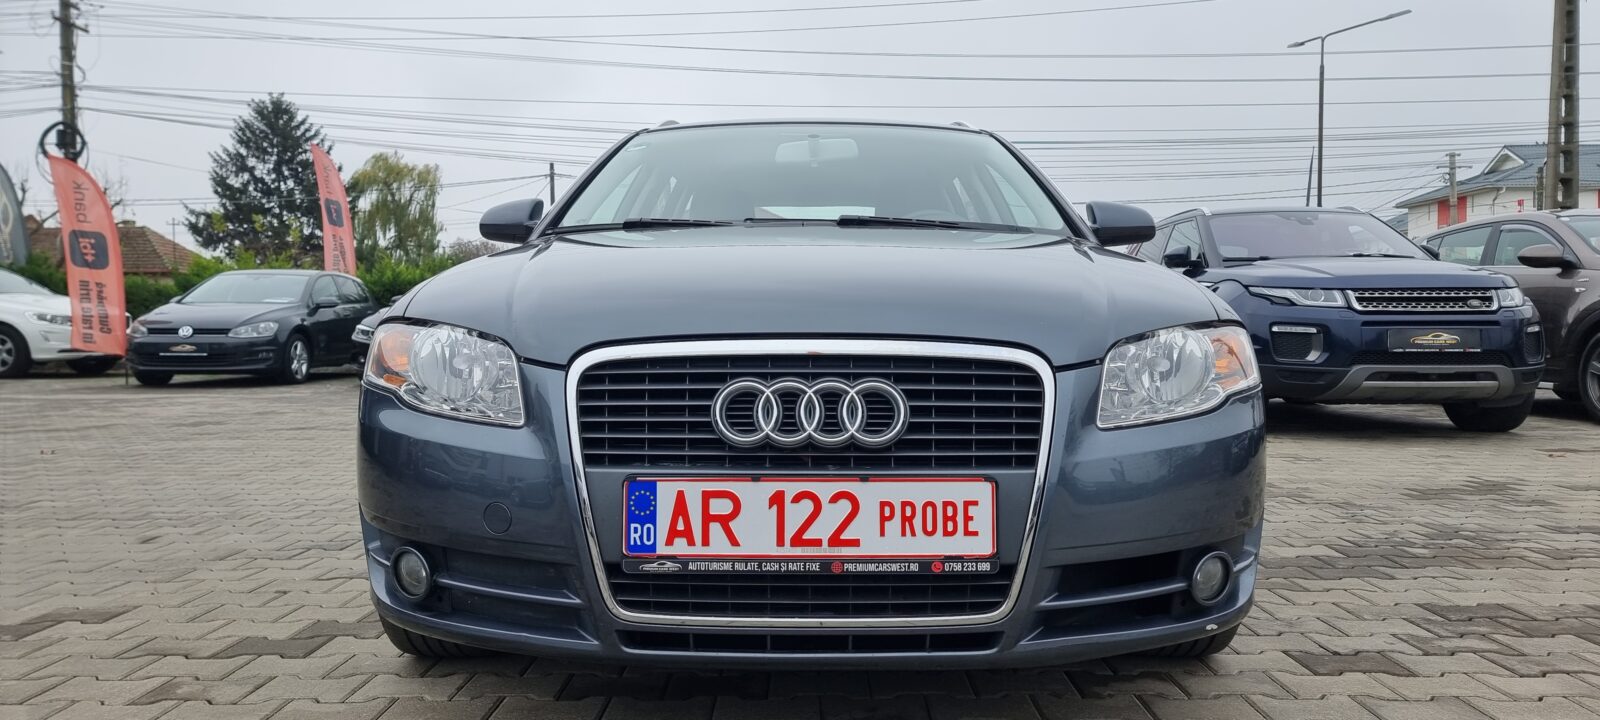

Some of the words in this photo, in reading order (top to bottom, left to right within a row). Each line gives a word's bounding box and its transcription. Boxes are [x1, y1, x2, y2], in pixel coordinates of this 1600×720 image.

[664, 489, 742, 547] AR
[768, 489, 861, 548] 122
[879, 500, 979, 537] PROBE
[630, 523, 655, 546] RO
[688, 562, 733, 571] AUTOTURISME
[734, 562, 761, 572] RULATE,
[762, 563, 780, 571] CASH
[788, 562, 805, 571] RATE
[806, 562, 820, 571] FIXE
[844, 562, 919, 572] PREMIUMCARSWEST.RO
[944, 562, 962, 571] 0758
[963, 562, 976, 571] 233
[977, 562, 990, 571] 699
